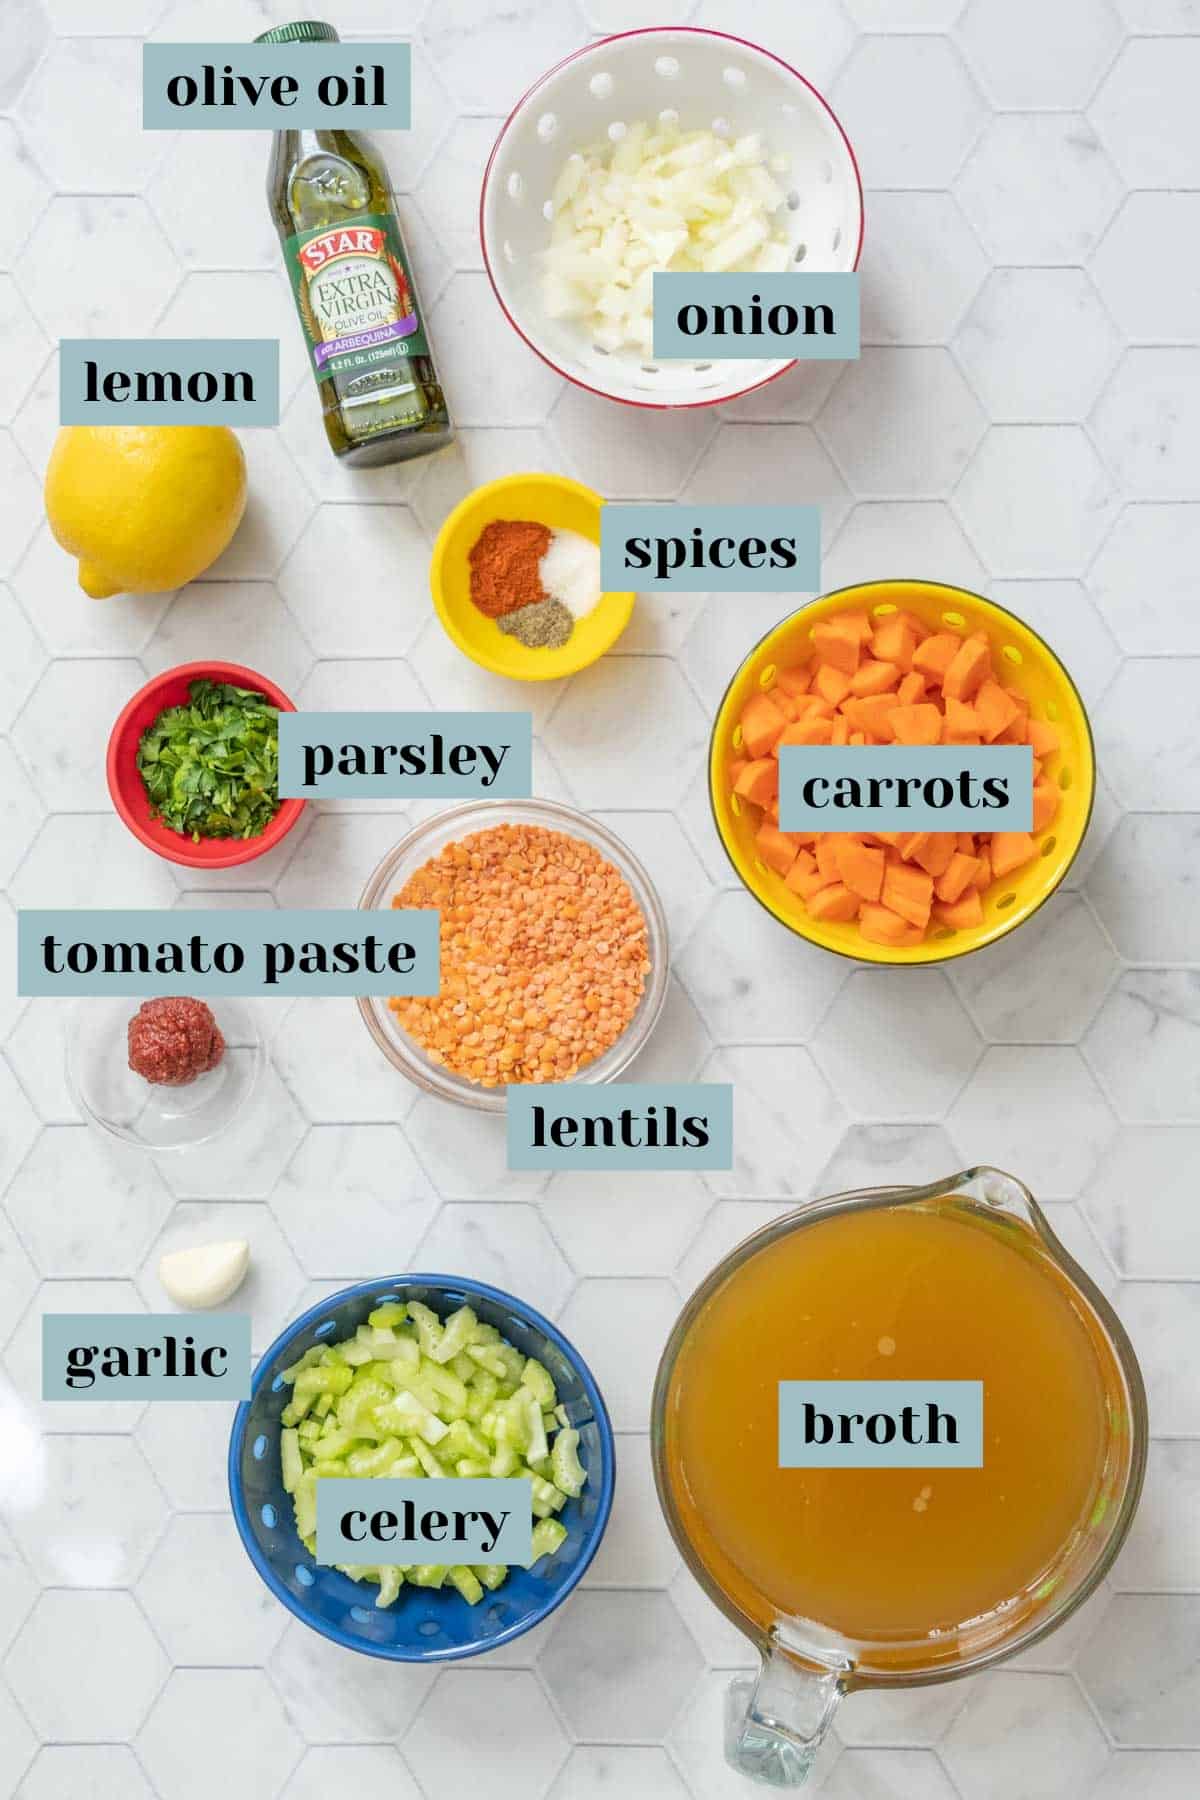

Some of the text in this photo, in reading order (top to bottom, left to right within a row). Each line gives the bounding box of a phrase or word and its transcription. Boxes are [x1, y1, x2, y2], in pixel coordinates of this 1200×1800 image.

[306, 231, 377, 265] STAR
[318, 270, 388, 302] EXTRA
[321, 287, 393, 319] VIRGIN
[335, 310, 385, 330] OLIVE OIL
[335, 327, 397, 353] ARBEQUINA
